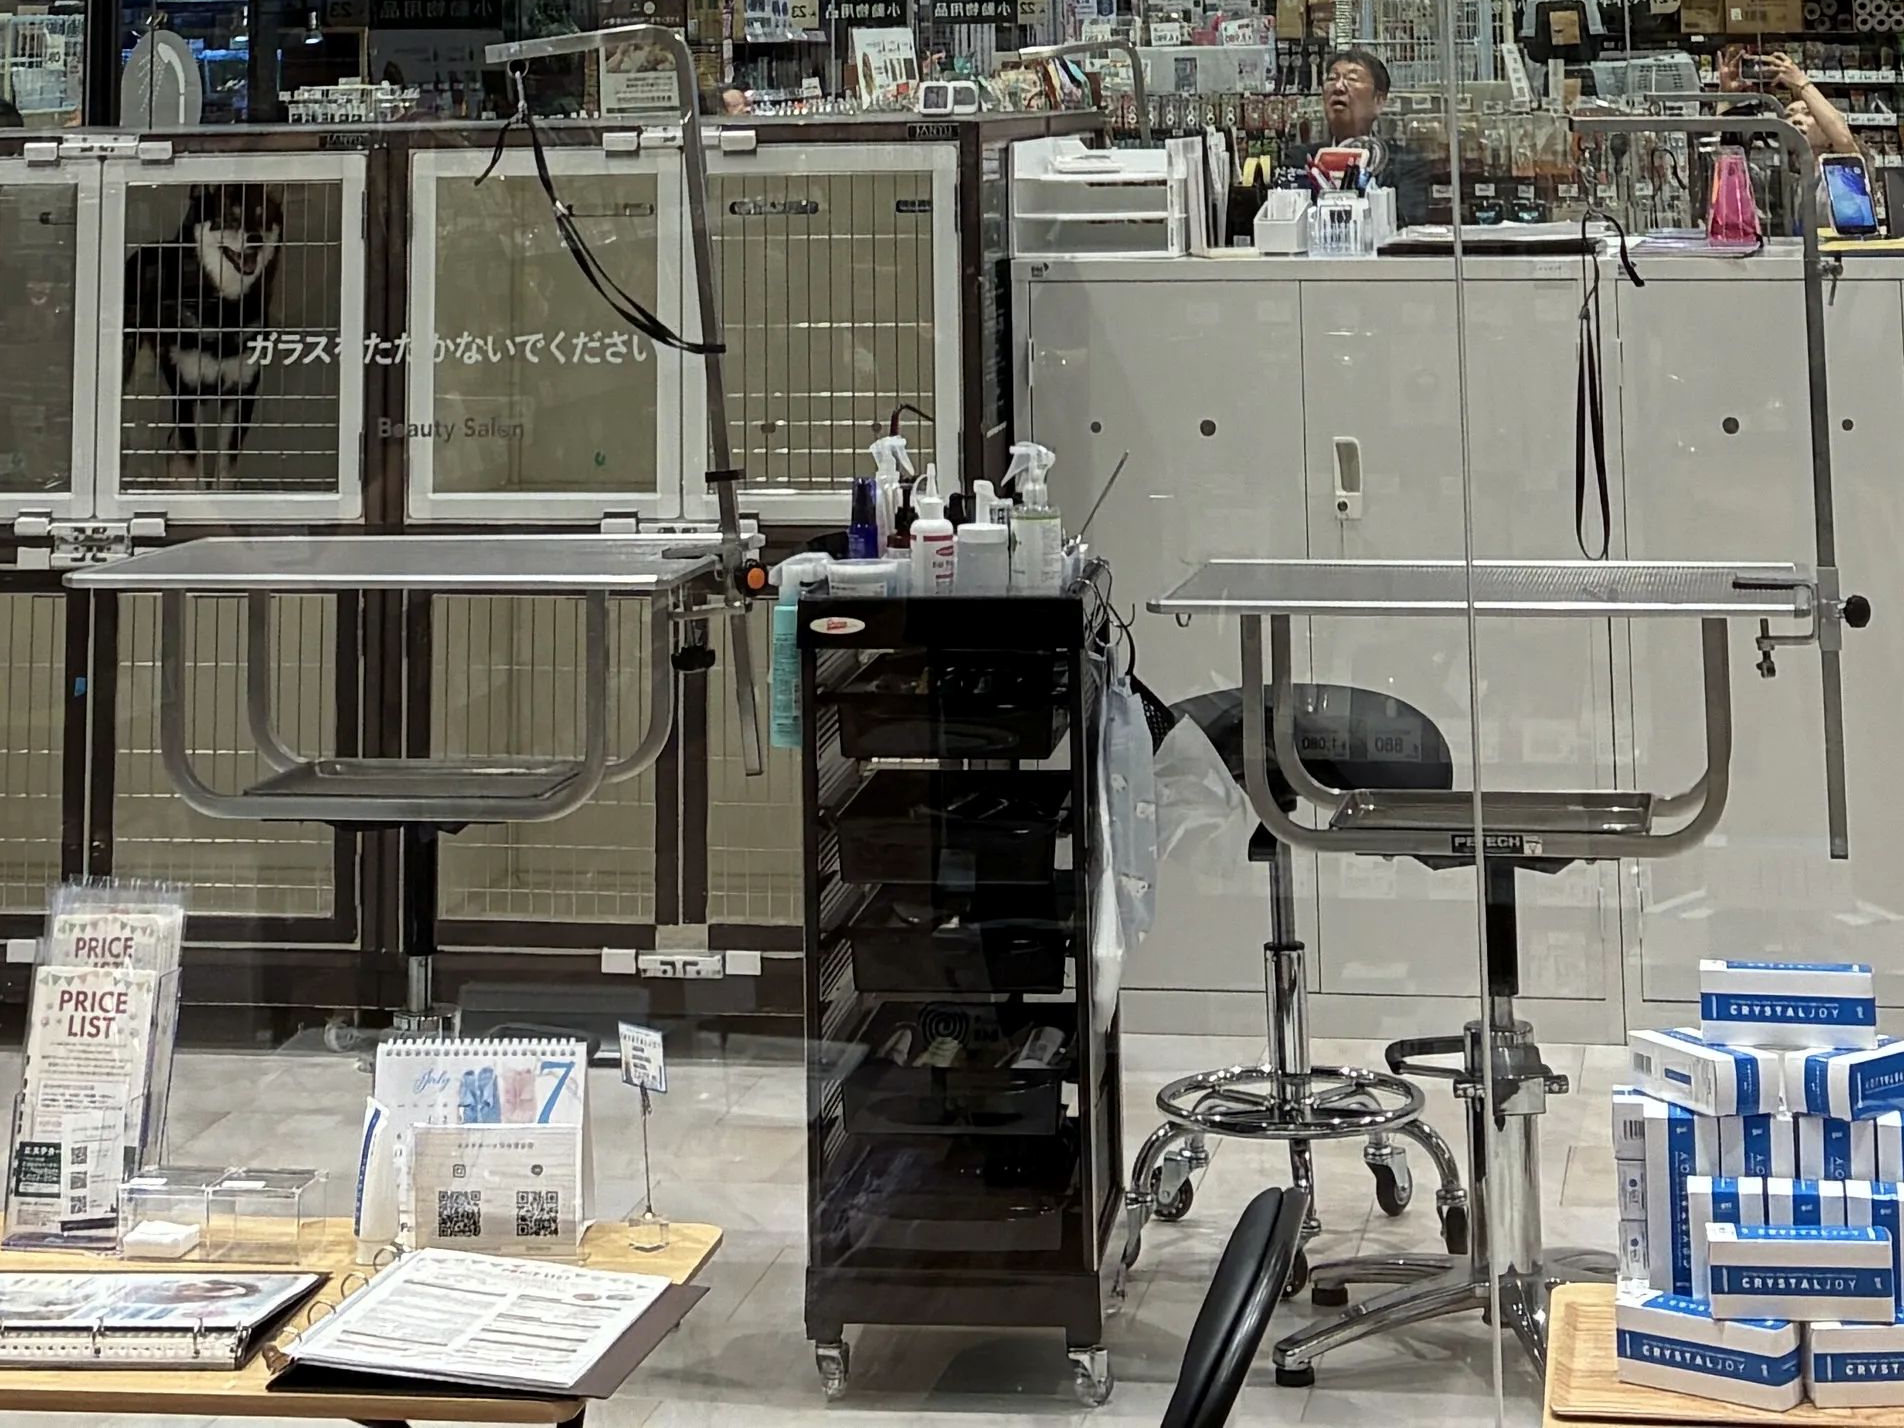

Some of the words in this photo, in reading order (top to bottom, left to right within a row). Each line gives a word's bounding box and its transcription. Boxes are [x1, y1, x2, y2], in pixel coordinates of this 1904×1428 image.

[246, 333, 654, 365] ガラスをたたかないでください
[59, 990, 128, 1014] PRICE
[1730, 1005, 1838, 1019] CRYSTALJOY
[67, 1016, 116, 1039] LIST
[537, 1061, 575, 1124] 7
[1742, 1277, 1856, 1291] CRYSTALJOY
[1643, 1345, 1745, 1373] CRYSTALJOY
